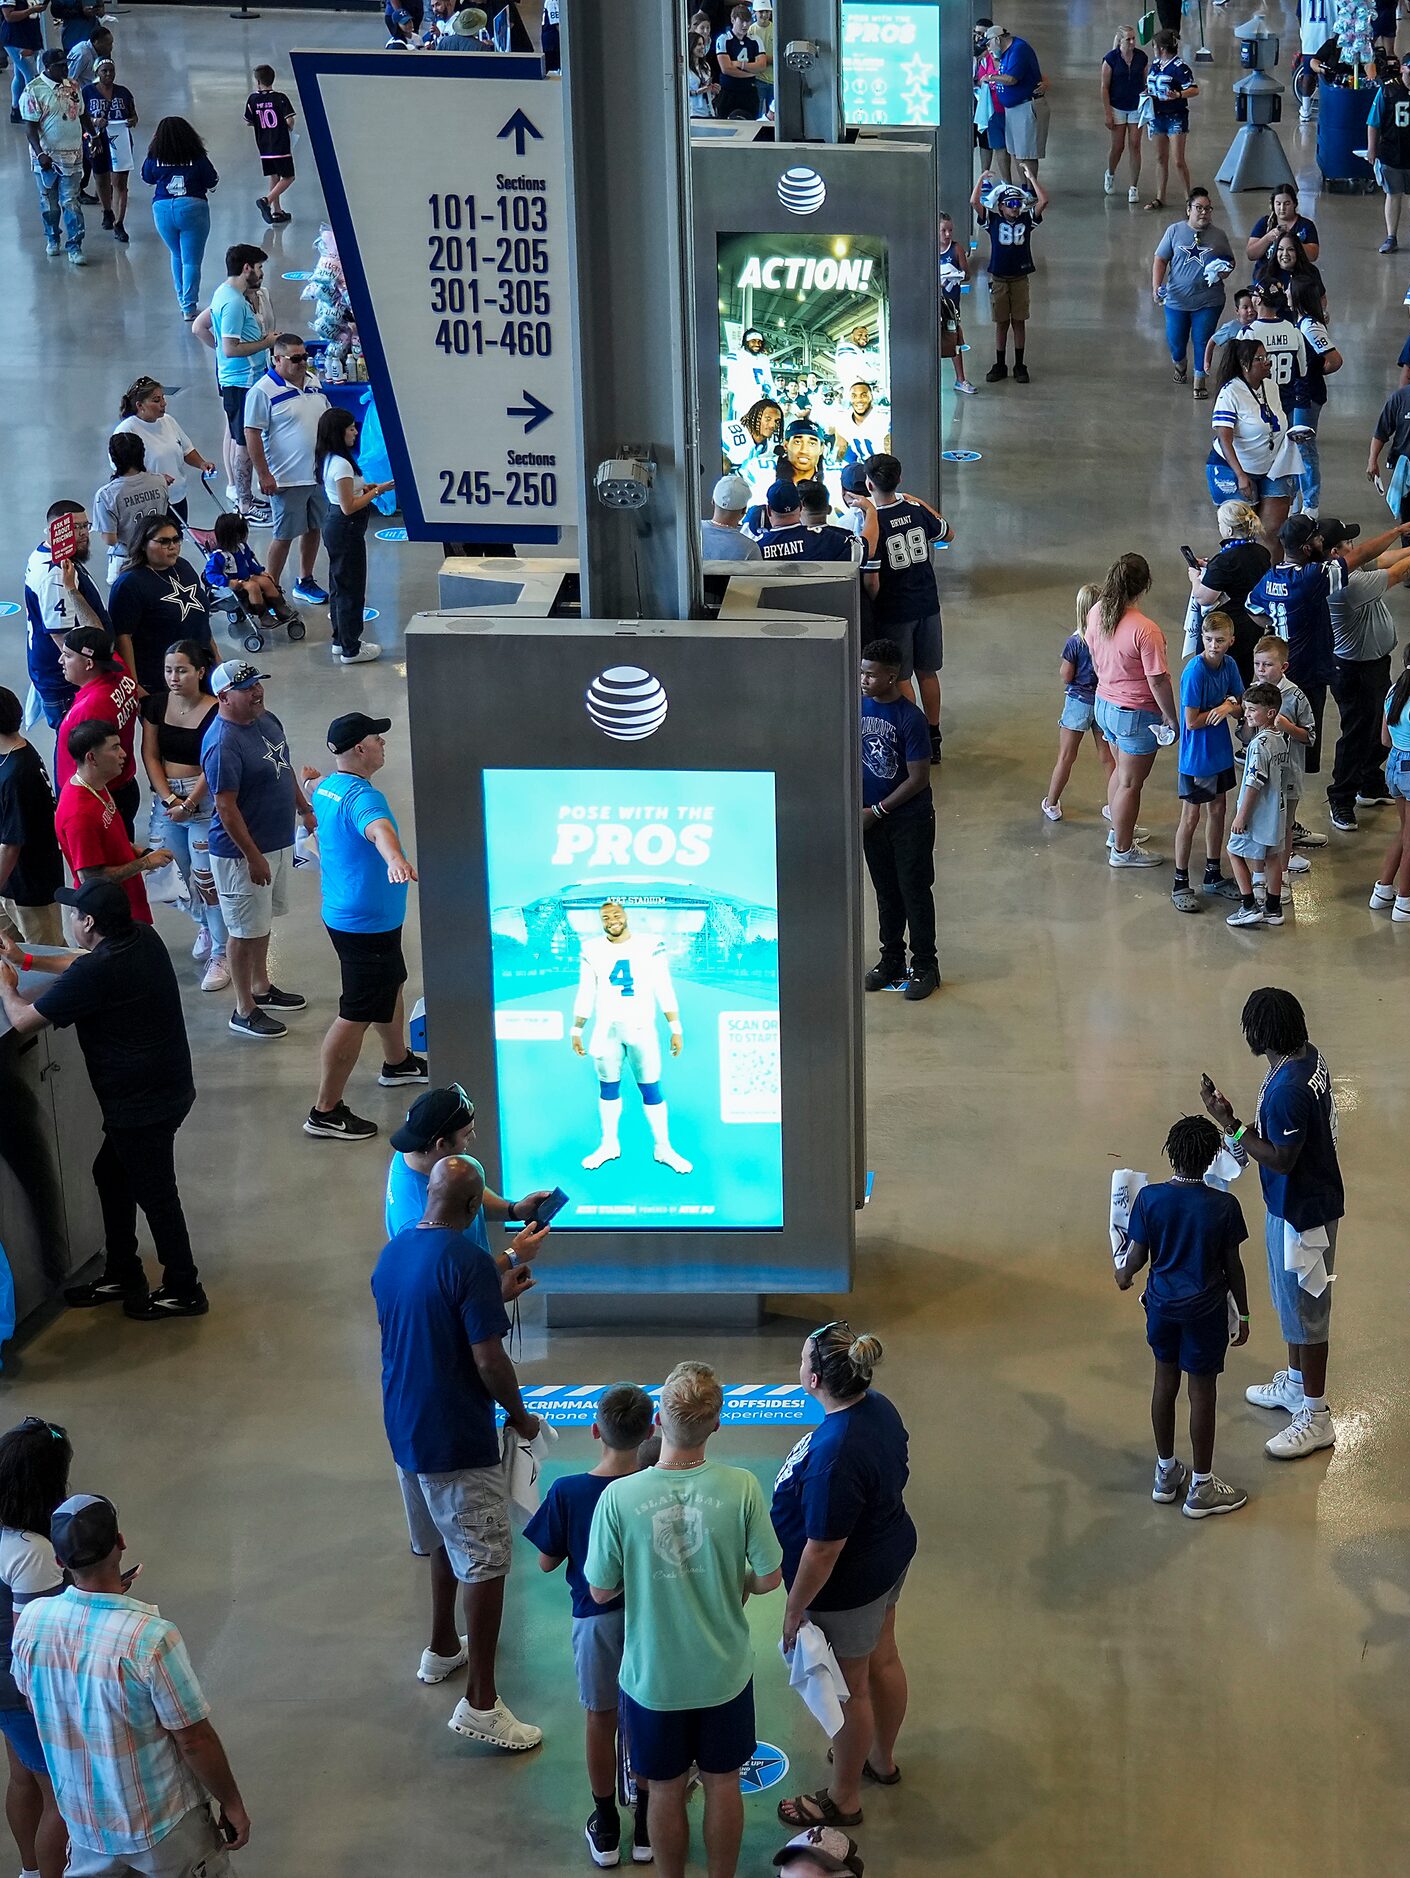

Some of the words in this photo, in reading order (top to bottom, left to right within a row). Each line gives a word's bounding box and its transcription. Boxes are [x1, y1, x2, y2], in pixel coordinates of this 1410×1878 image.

[845, 22, 917, 45] PROS
[256, 109, 278, 129] 10
[166, 175, 186, 196] 4
[496, 174, 547, 191] Sections
[428, 193, 548, 233] 101-103
[998, 222, 1026, 246] 88
[428, 236, 550, 274] 201-205
[737, 257, 874, 292] ACTION!
[430, 277, 551, 316] 301-305
[435, 320, 552, 356] 401-460
[1266, 335, 1288, 347] LAMB
[507, 450, 556, 466] Sections
[124, 488, 161, 508] PARSONS
[439, 470, 557, 507] 245-250
[890, 514, 912, 529] BRYANT
[763, 540, 804, 559] BRYANT
[886, 527, 928, 570] 88
[54, 599, 67, 617] 4
[110, 675, 136, 709] 50/50
[559, 805, 611, 820] POSE
[618, 805, 669, 820] WITH
[677, 805, 716, 820] THE
[551, 823, 714, 868] PROS
[628, 896, 667, 905] STADIUM
[609, 959, 635, 997] 4
[728, 1019, 759, 1031] SCAN
[745, 1033, 777, 1042] START
[727, 1400, 805, 1409] OFFSIDES!
[695, 1494, 724, 1509] BAY
